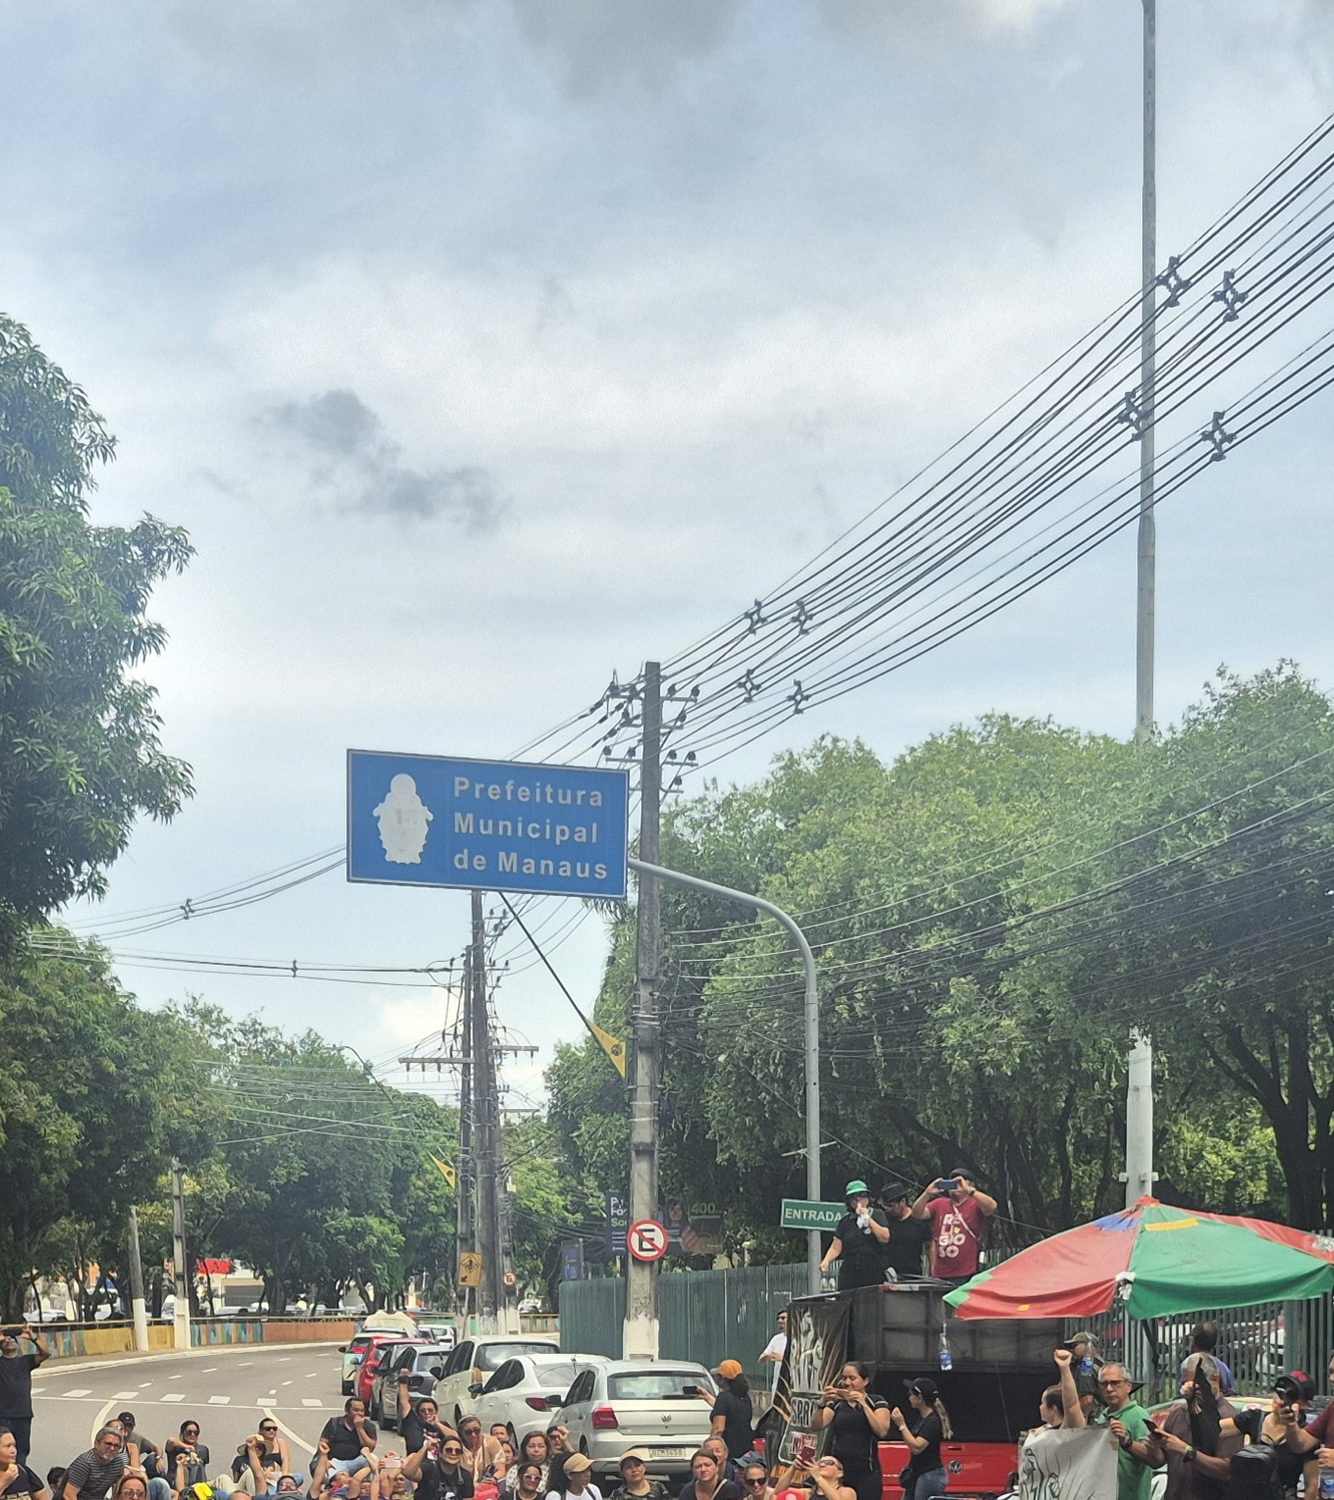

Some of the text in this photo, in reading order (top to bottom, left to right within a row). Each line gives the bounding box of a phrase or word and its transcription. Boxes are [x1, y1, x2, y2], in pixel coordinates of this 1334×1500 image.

[453, 776, 603, 807] Prefeitura
[453, 811, 598, 845] Municipal
[453, 849, 608, 879] de Manaus
[785, 1208, 842, 1222] ENTRADA
